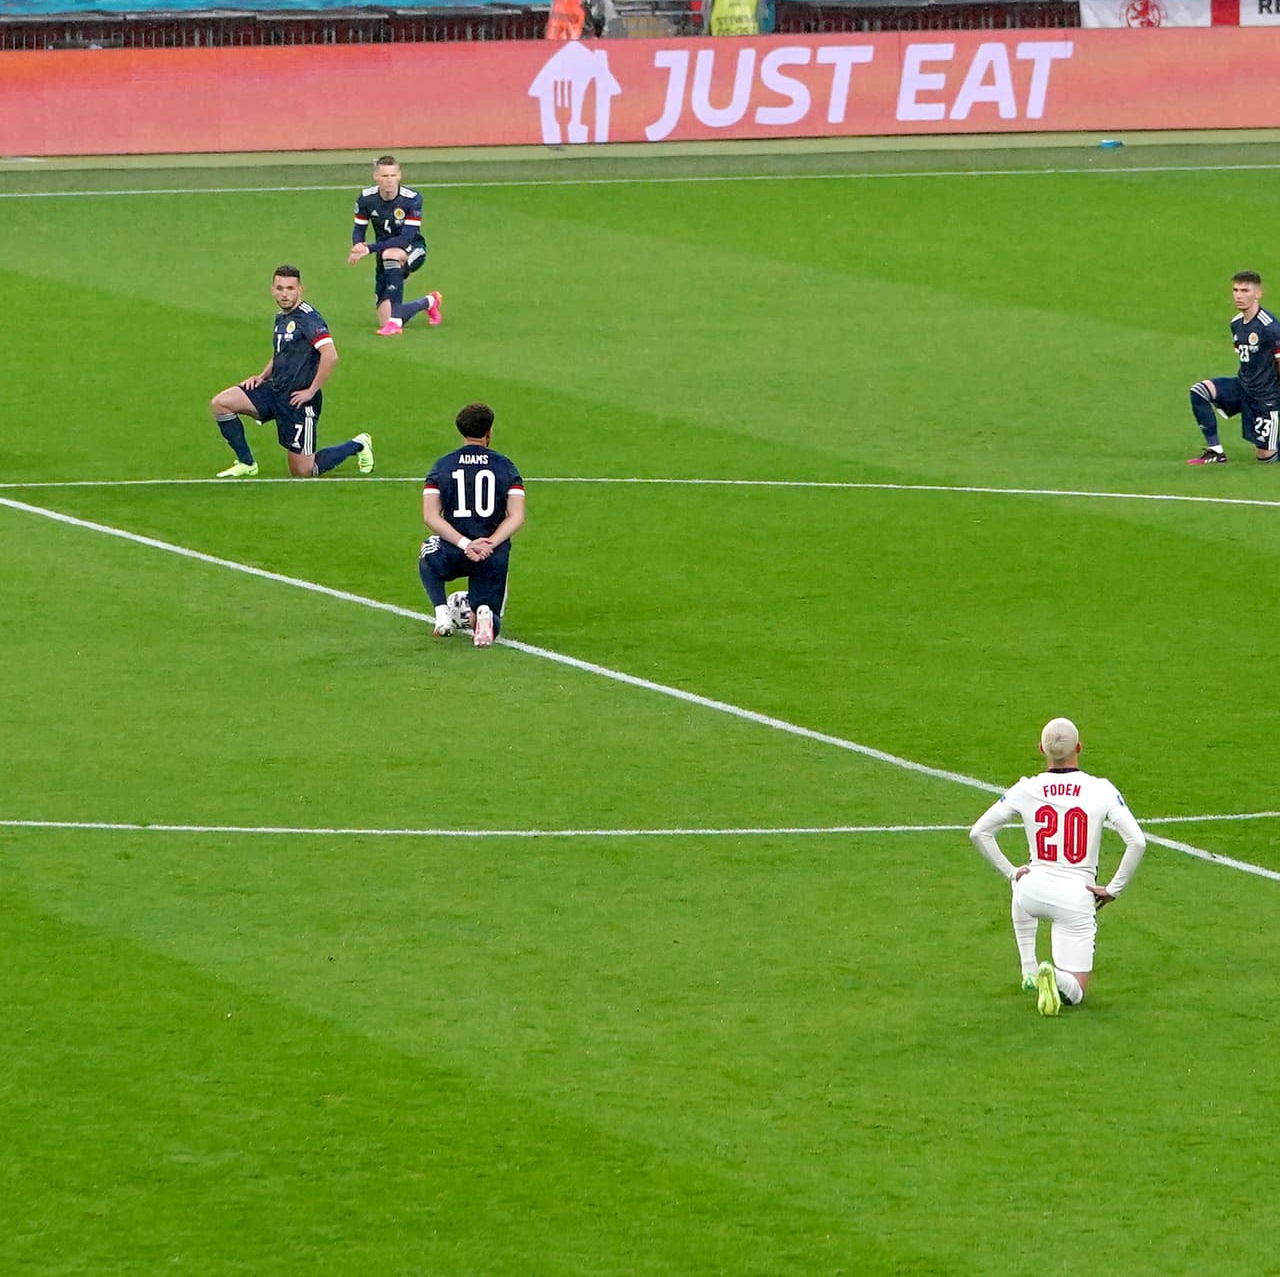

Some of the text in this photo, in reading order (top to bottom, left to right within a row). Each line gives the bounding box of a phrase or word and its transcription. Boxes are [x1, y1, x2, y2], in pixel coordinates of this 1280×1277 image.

[644, 41, 1075, 142] JUST EAT
[384, 218, 392, 234] 4
[1238, 344, 1250, 363] 23
[294, 423, 304, 443] 7
[1254, 416, 1272, 438] 23
[458, 454, 490, 465] ADAMS
[451, 468, 496, 518] 10
[1042, 783, 1082, 798] FODEN
[1034, 804, 1089, 865] 20
